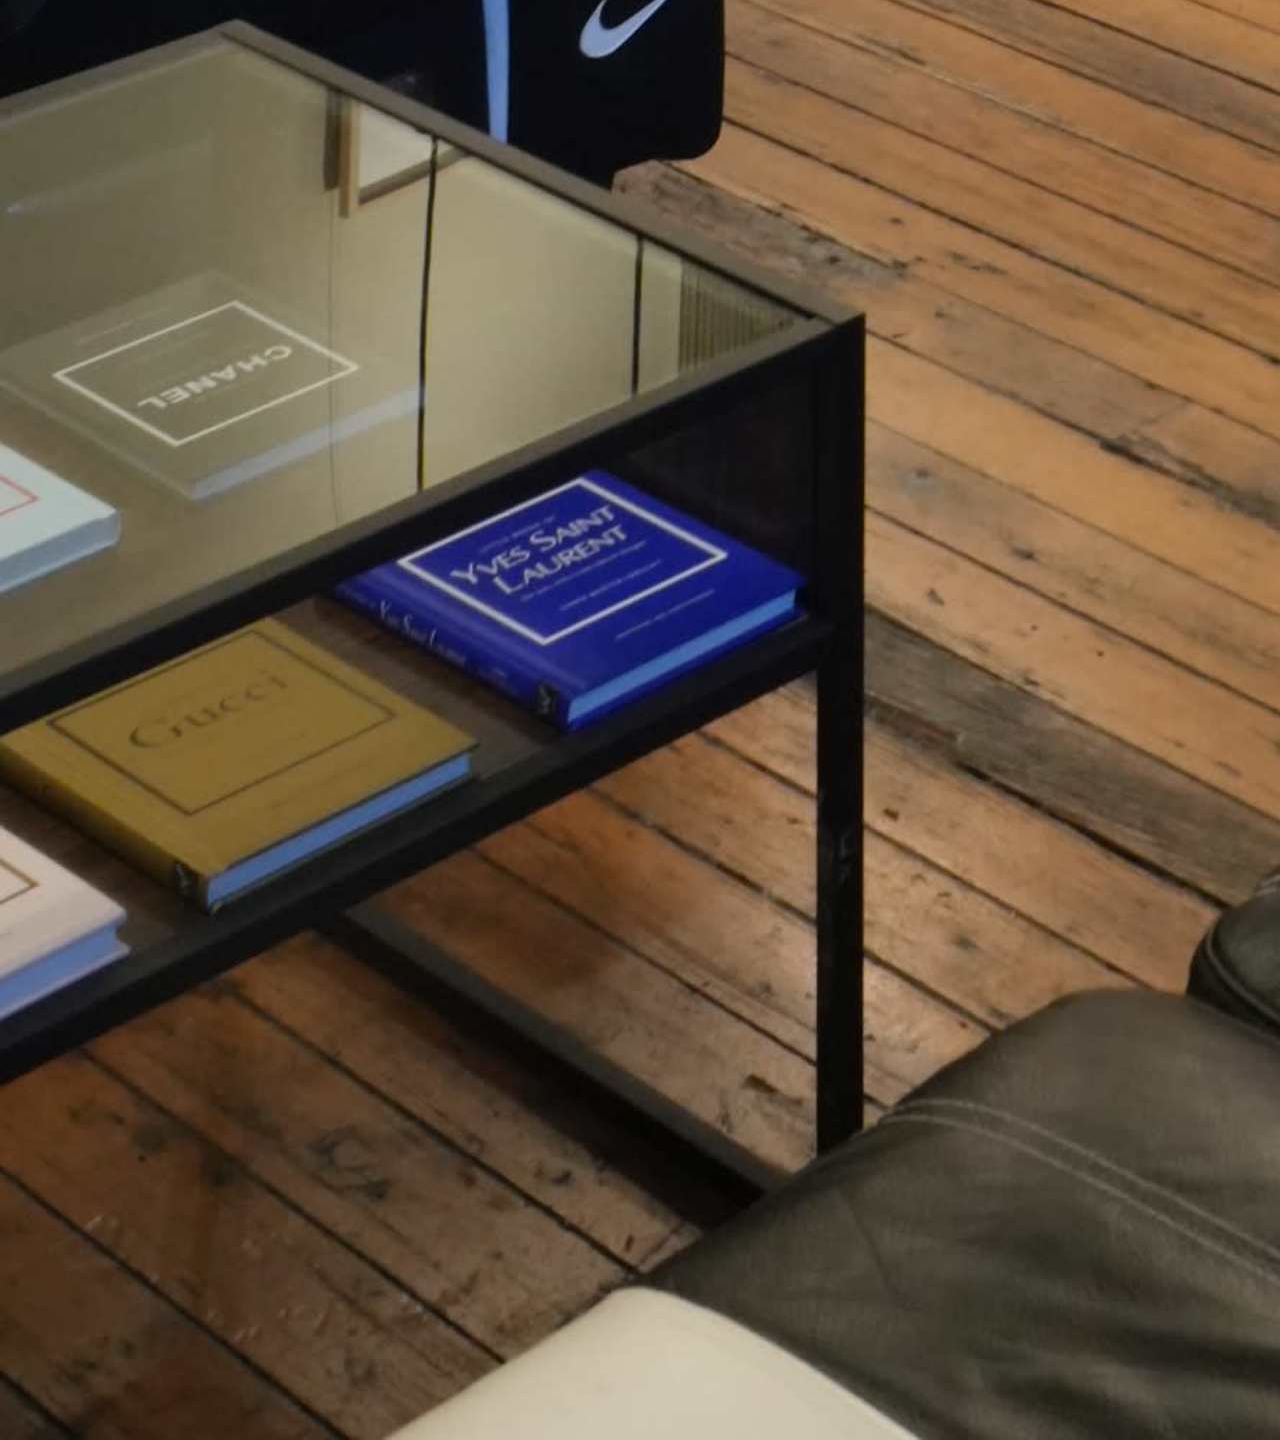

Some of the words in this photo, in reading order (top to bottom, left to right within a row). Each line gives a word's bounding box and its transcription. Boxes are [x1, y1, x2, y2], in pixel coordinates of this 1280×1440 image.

[137, 346, 292, 408] CHANEL
[450, 545, 531, 585] YVES
[530, 505, 614, 553] SAINT
[493, 525, 627, 595] LAURENT
[129, 670, 287, 748] Gucci
